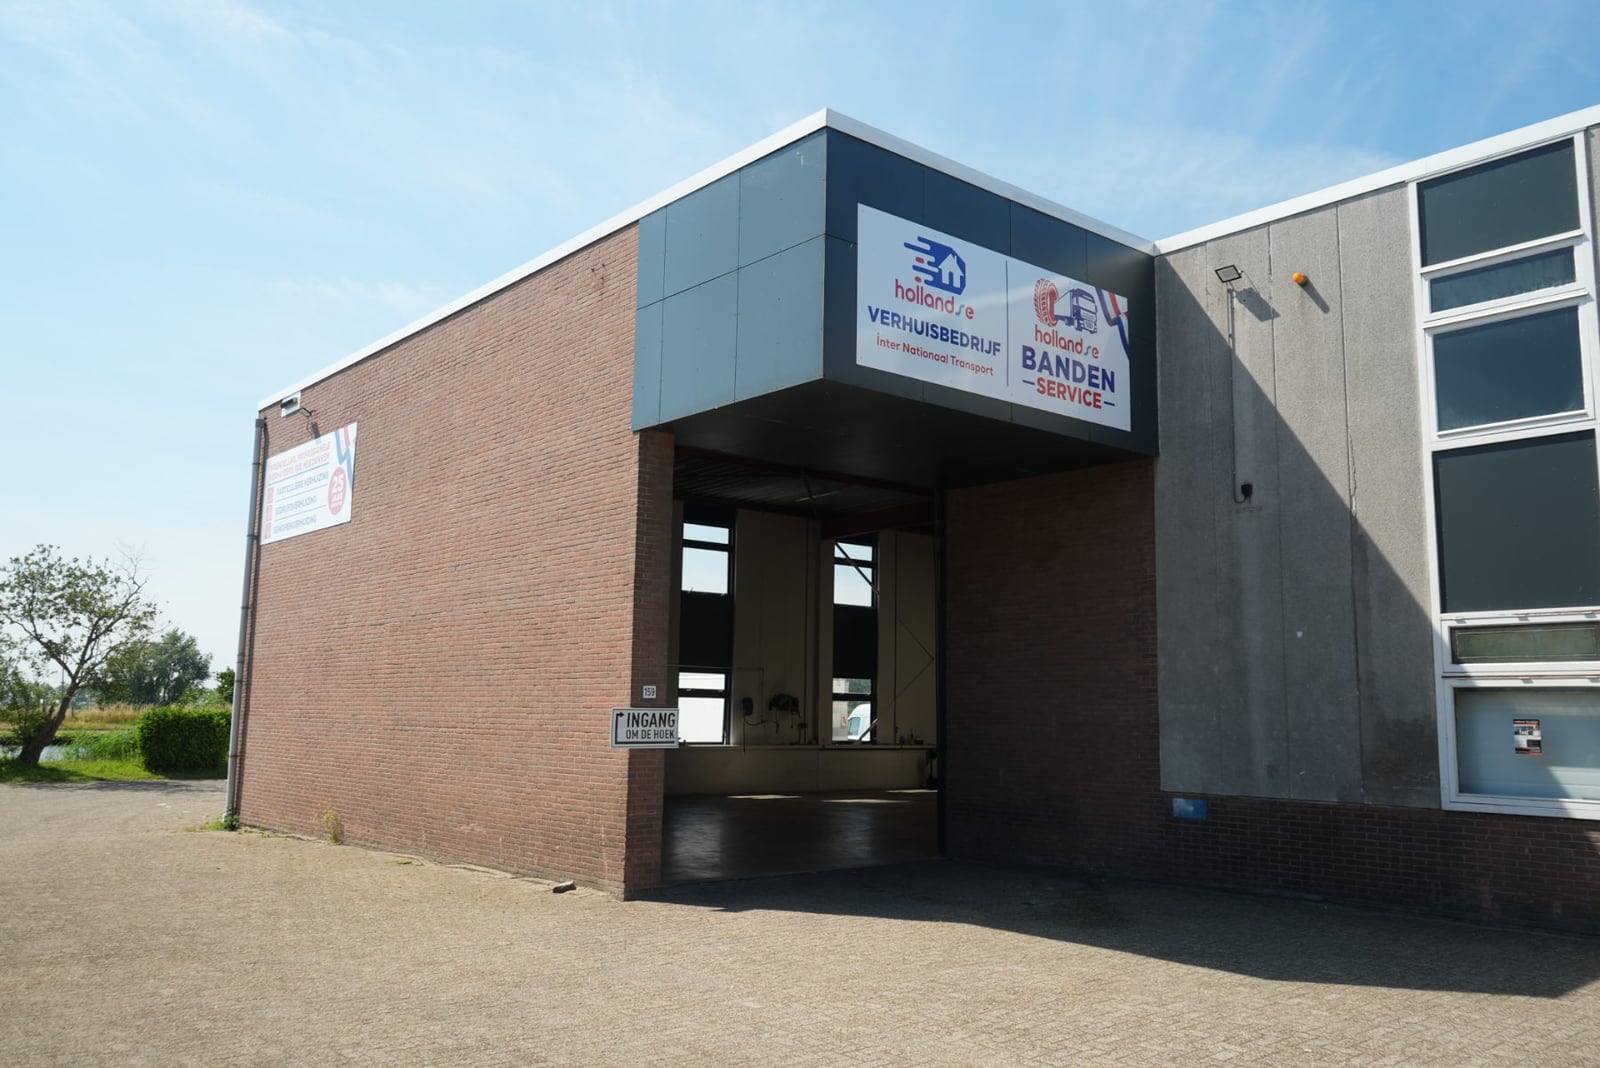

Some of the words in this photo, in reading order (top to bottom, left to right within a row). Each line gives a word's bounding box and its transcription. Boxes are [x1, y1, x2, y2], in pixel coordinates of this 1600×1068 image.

[868, 305, 1001, 356] VERHUISBEDRIJF
[876, 332, 901, 351] inter
[902, 342, 949, 364] Nationaal
[950, 355, 995, 376] Transport
[1022, 344, 1116, 394] BANDEN
[1037, 377, 1102, 409] SERVICE
[644, 687, 655, 697] 159
[625, 729, 639, 740] OM
[641, 729, 652, 740] DE
[653, 729, 675, 740] HOEK
[626, 712, 676, 728] INGANG
